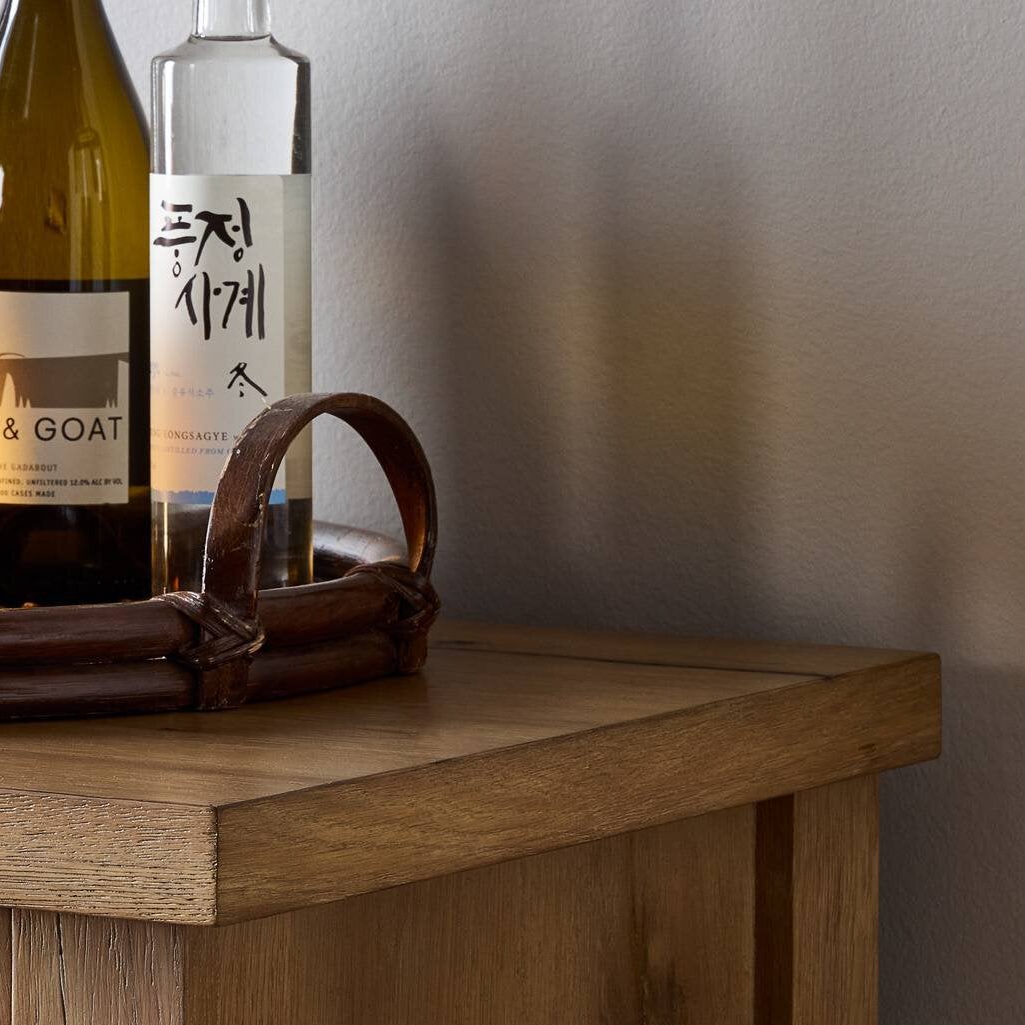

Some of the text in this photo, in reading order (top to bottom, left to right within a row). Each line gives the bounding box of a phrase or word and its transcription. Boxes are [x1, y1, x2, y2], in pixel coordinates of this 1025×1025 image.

[175, 263, 265, 340] 사계
[2, 417, 20, 441] &
[34, 416, 122, 442] GOAT
[199, 447, 225, 456] FROM
[10, 462, 58, 473] GADABOUT
[26, 477, 69, 487] UNFILTERED
[10, 489, 33, 499] CASES
[34, 489, 56, 499] MADE
